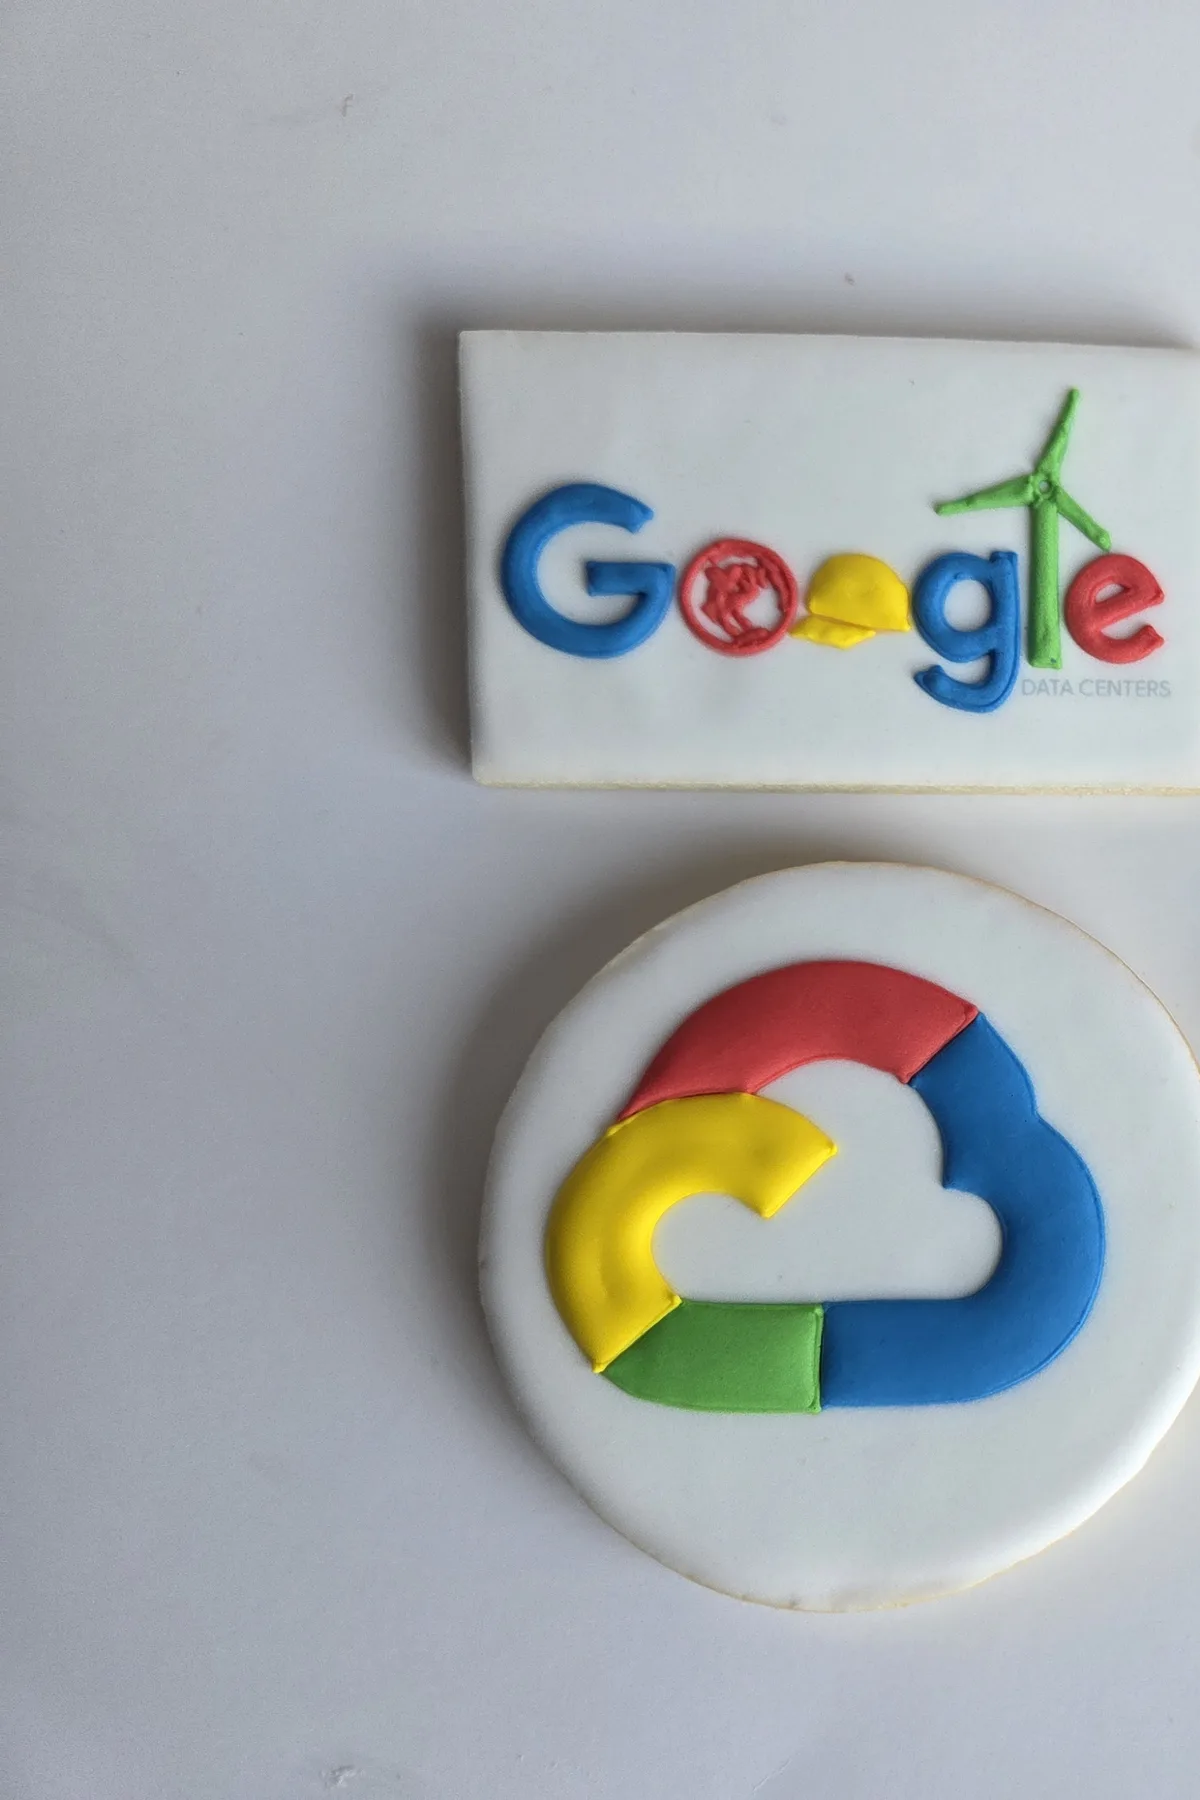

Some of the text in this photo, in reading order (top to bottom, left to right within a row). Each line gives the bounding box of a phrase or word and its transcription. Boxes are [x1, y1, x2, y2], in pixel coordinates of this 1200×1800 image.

[501, 388, 1166, 715] Google
[1021, 678, 1171, 698] DATA CENTERS
